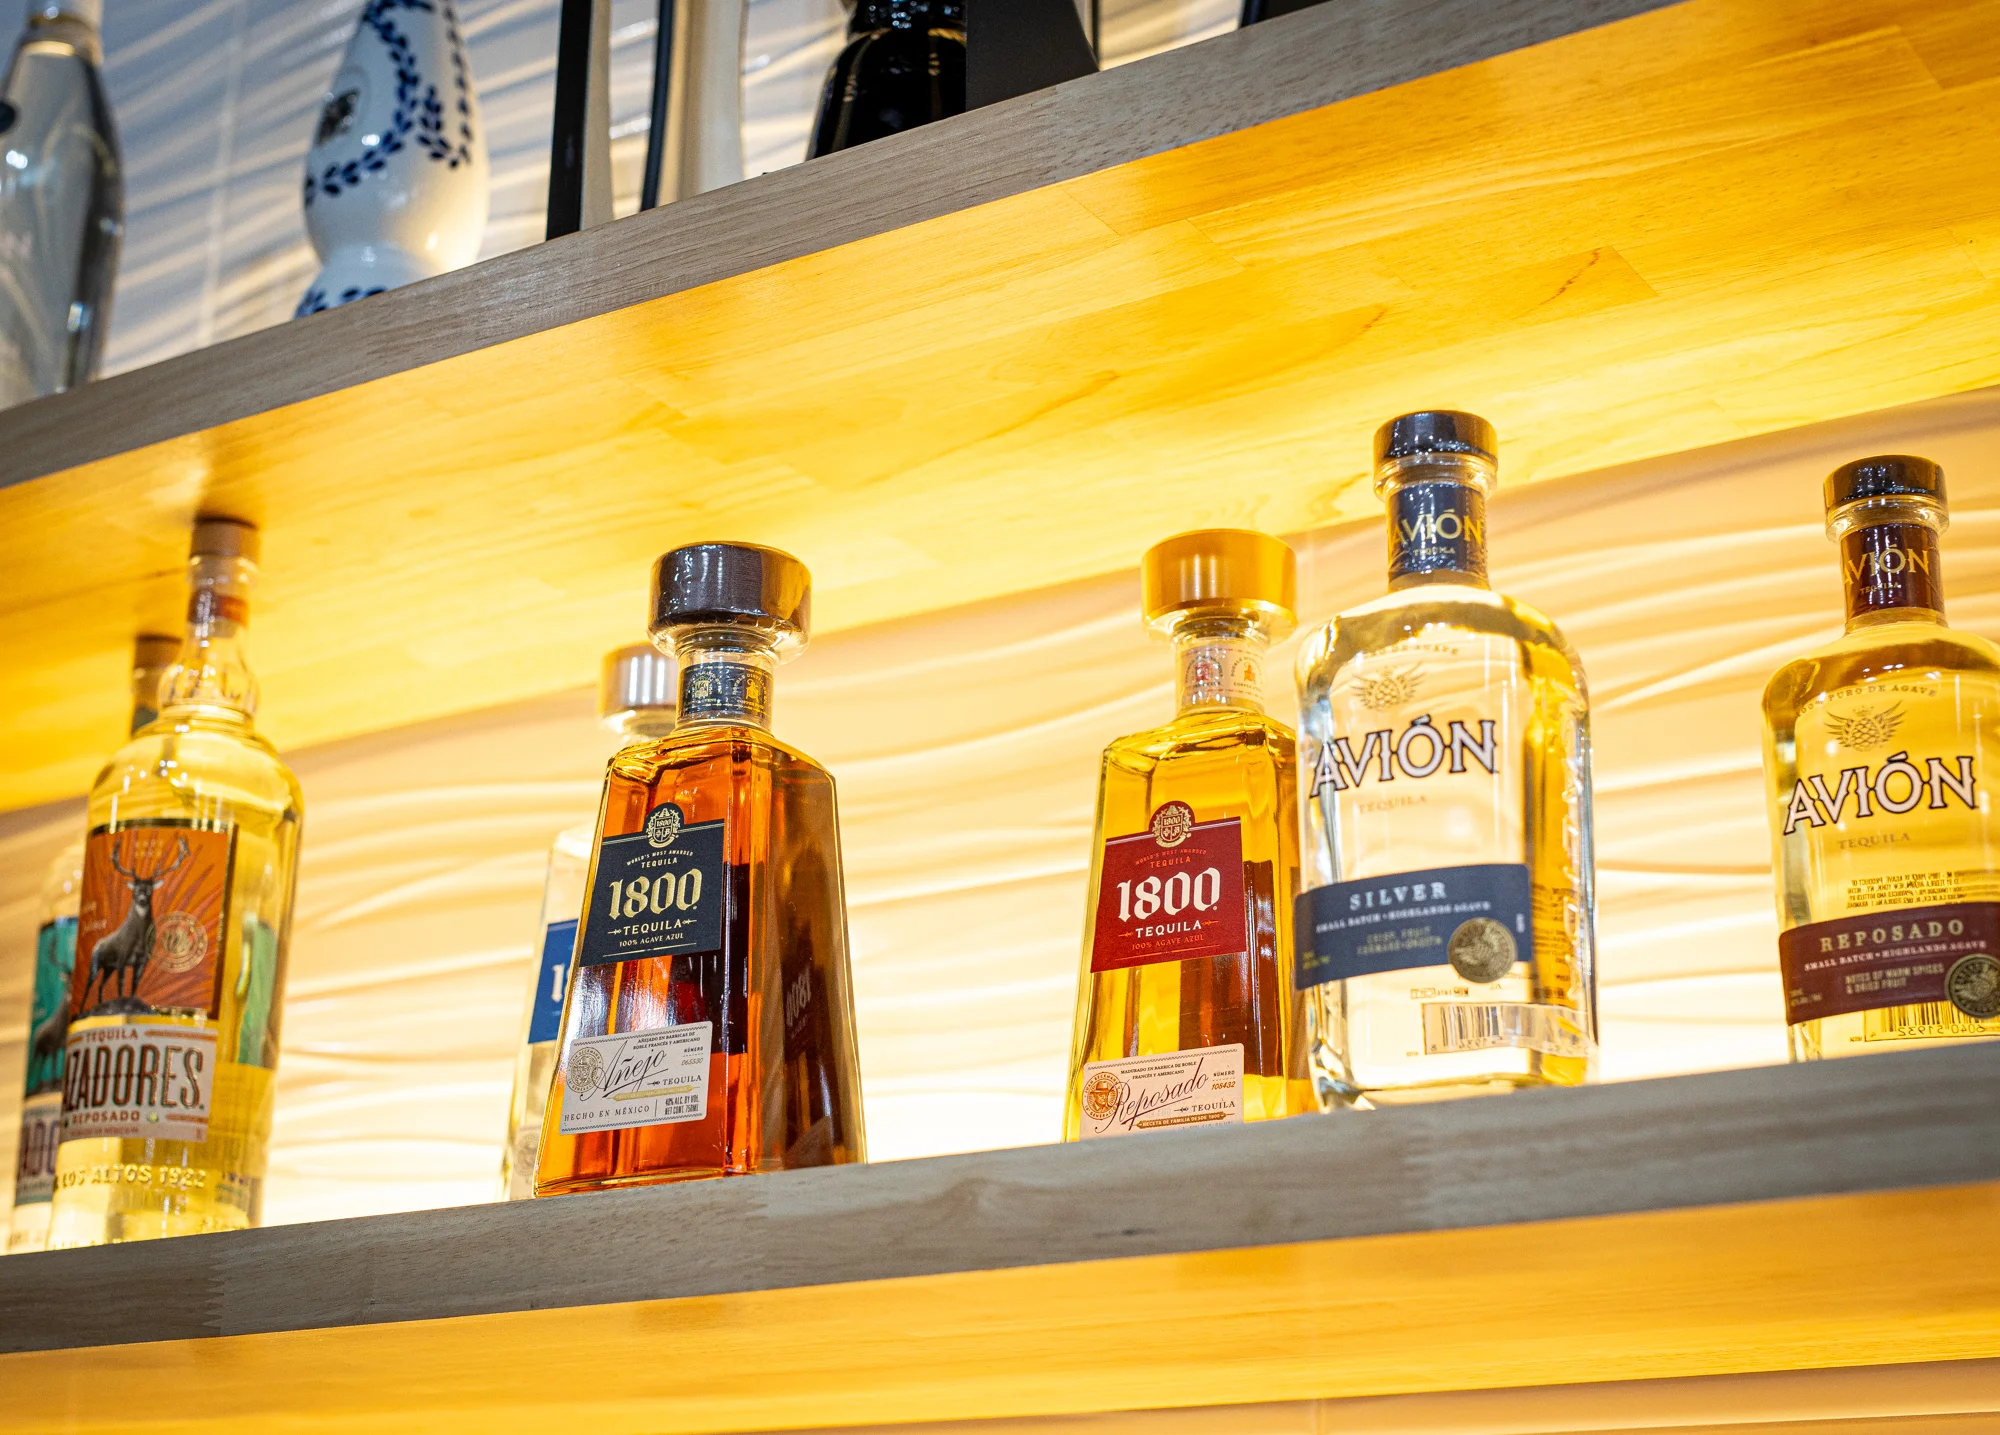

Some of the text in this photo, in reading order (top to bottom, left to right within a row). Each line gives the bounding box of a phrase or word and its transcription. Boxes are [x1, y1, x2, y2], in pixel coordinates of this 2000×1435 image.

[1892, 684, 1936, 697] AGAVE
[1310, 714, 1499, 798] AVIÓN
[1783, 750, 1976, 835] AVIÓN
[1838, 832, 1910, 850] TEQUILA
[641, 858, 678, 868] TEQUILA
[1150, 856, 1190, 868] TEQUILA
[608, 868, 702, 920] 1800
[1116, 867, 1220, 922] 1800
[1350, 882, 1447, 910] SILVER
[623, 919, 682, 936] TEQUILA
[1136, 920, 1202, 938] TEQUILA
[1316, 919, 1346, 933] SMALL
[1348, 913, 1381, 927] BATCH
[620, 932, 684, 948] 100% AGAVE AZUL
[1132, 934, 1204, 950] 100% AGAVE AZUL
[1820, 918, 1964, 952] REPOSADO
[1804, 940, 1987, 972] SMALL BATCH HIGHLANDS AGAVE
[1872, 970, 1884, 981] OF
[1886, 966, 1912, 978] WARM
[1912, 964, 1944, 976] SPICES
[1882, 978, 1906, 988] FRUIT
[86, 1028, 139, 1043] TEQUILA
[580, 1039, 668, 1101] Añejo
[663, 1074, 702, 1086] TEQUILA
[1094, 1056, 1208, 1134] Reposado
[564, 1105, 650, 1122] HECHO EN MÉXICO
[1191, 1101, 1235, 1112] TEQUILA
[72, 1110, 140, 1124] REPOSADO
[91, 1164, 152, 1184] ALTOS
